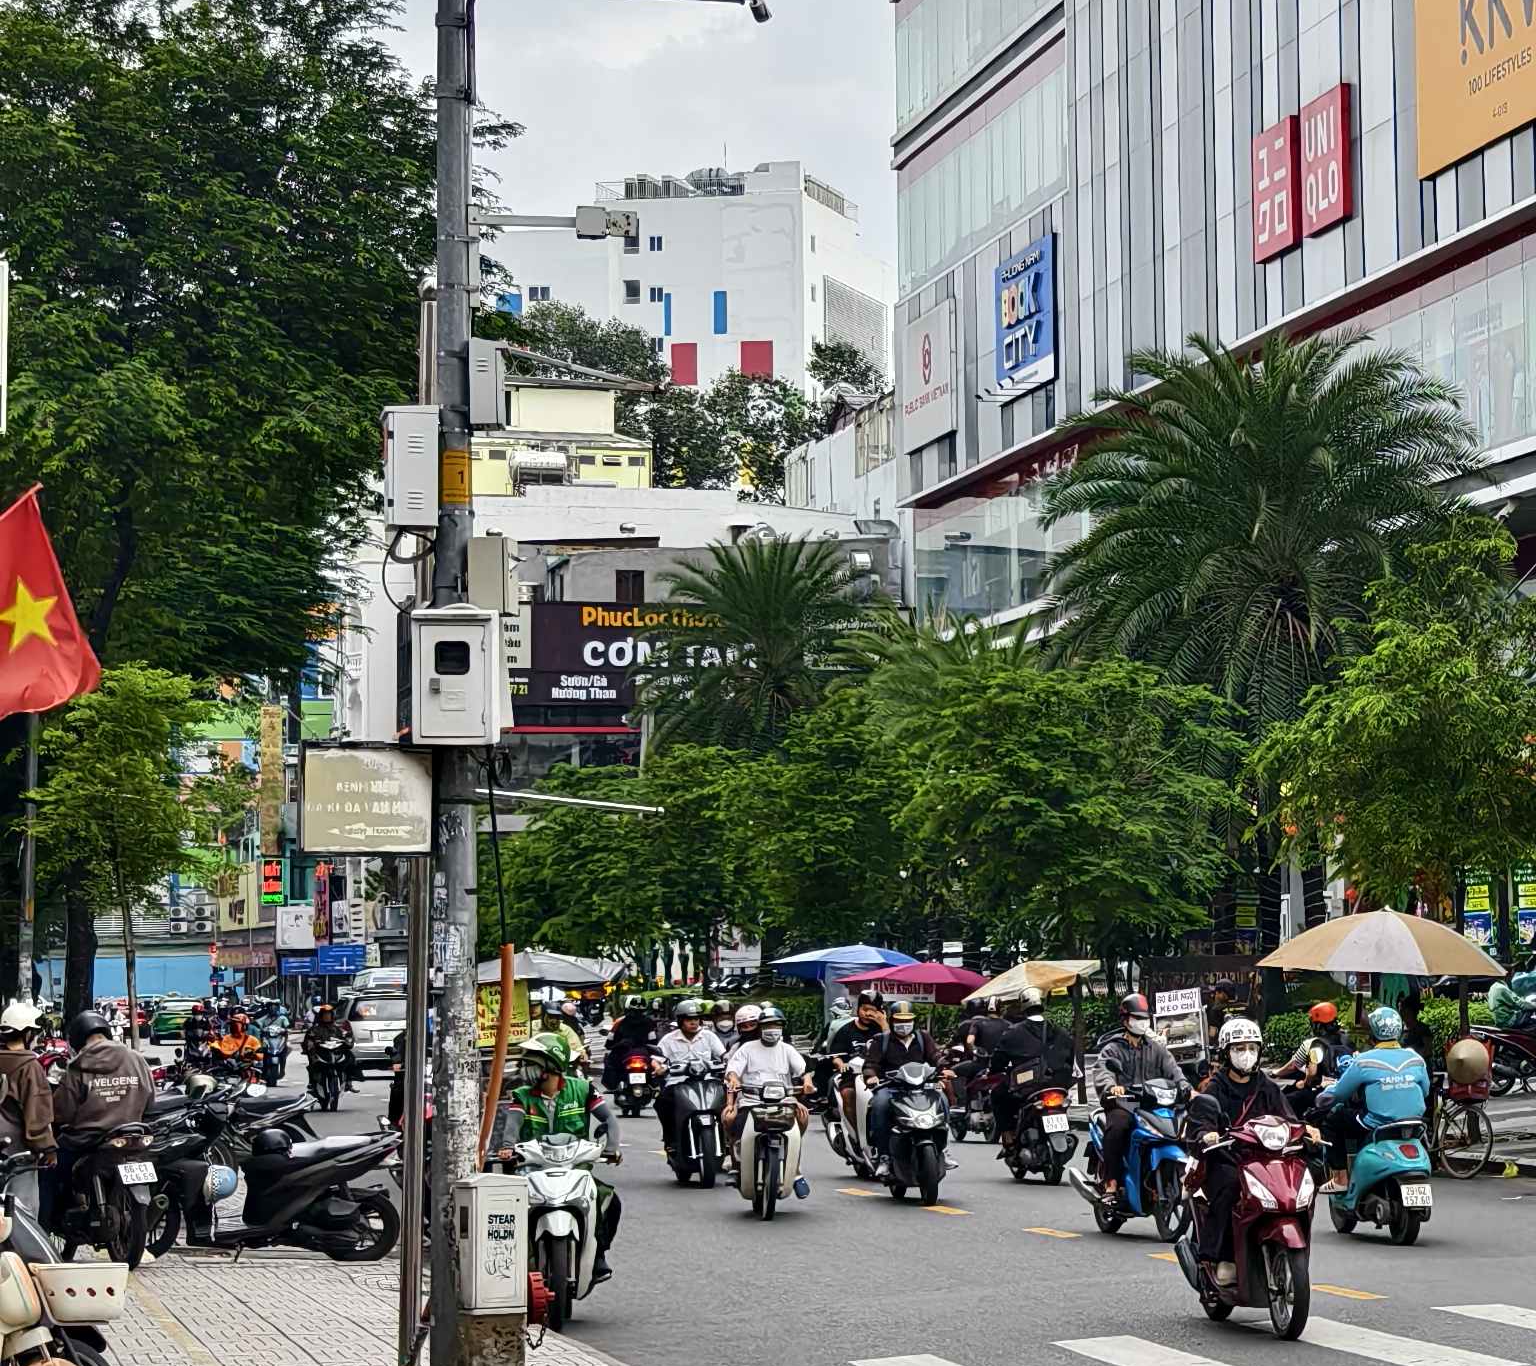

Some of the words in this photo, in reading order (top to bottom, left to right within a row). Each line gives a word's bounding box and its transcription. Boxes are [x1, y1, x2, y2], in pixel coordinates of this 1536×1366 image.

[1469, 74, 1483, 96] 100
[1484, 46, 1532, 88] LIFESTYLES
[1305, 105, 1335, 163] UNI
[1258, 136, 1287, 192] ユニ
[1306, 160, 1338, 223] QLO
[1258, 189, 1287, 245] クロ
[1001, 272, 1041, 329] BOOK
[1003, 320, 1041, 370] CITY
[458, 470, 464, 484] 1
[589, 687, 617, 699] Than
